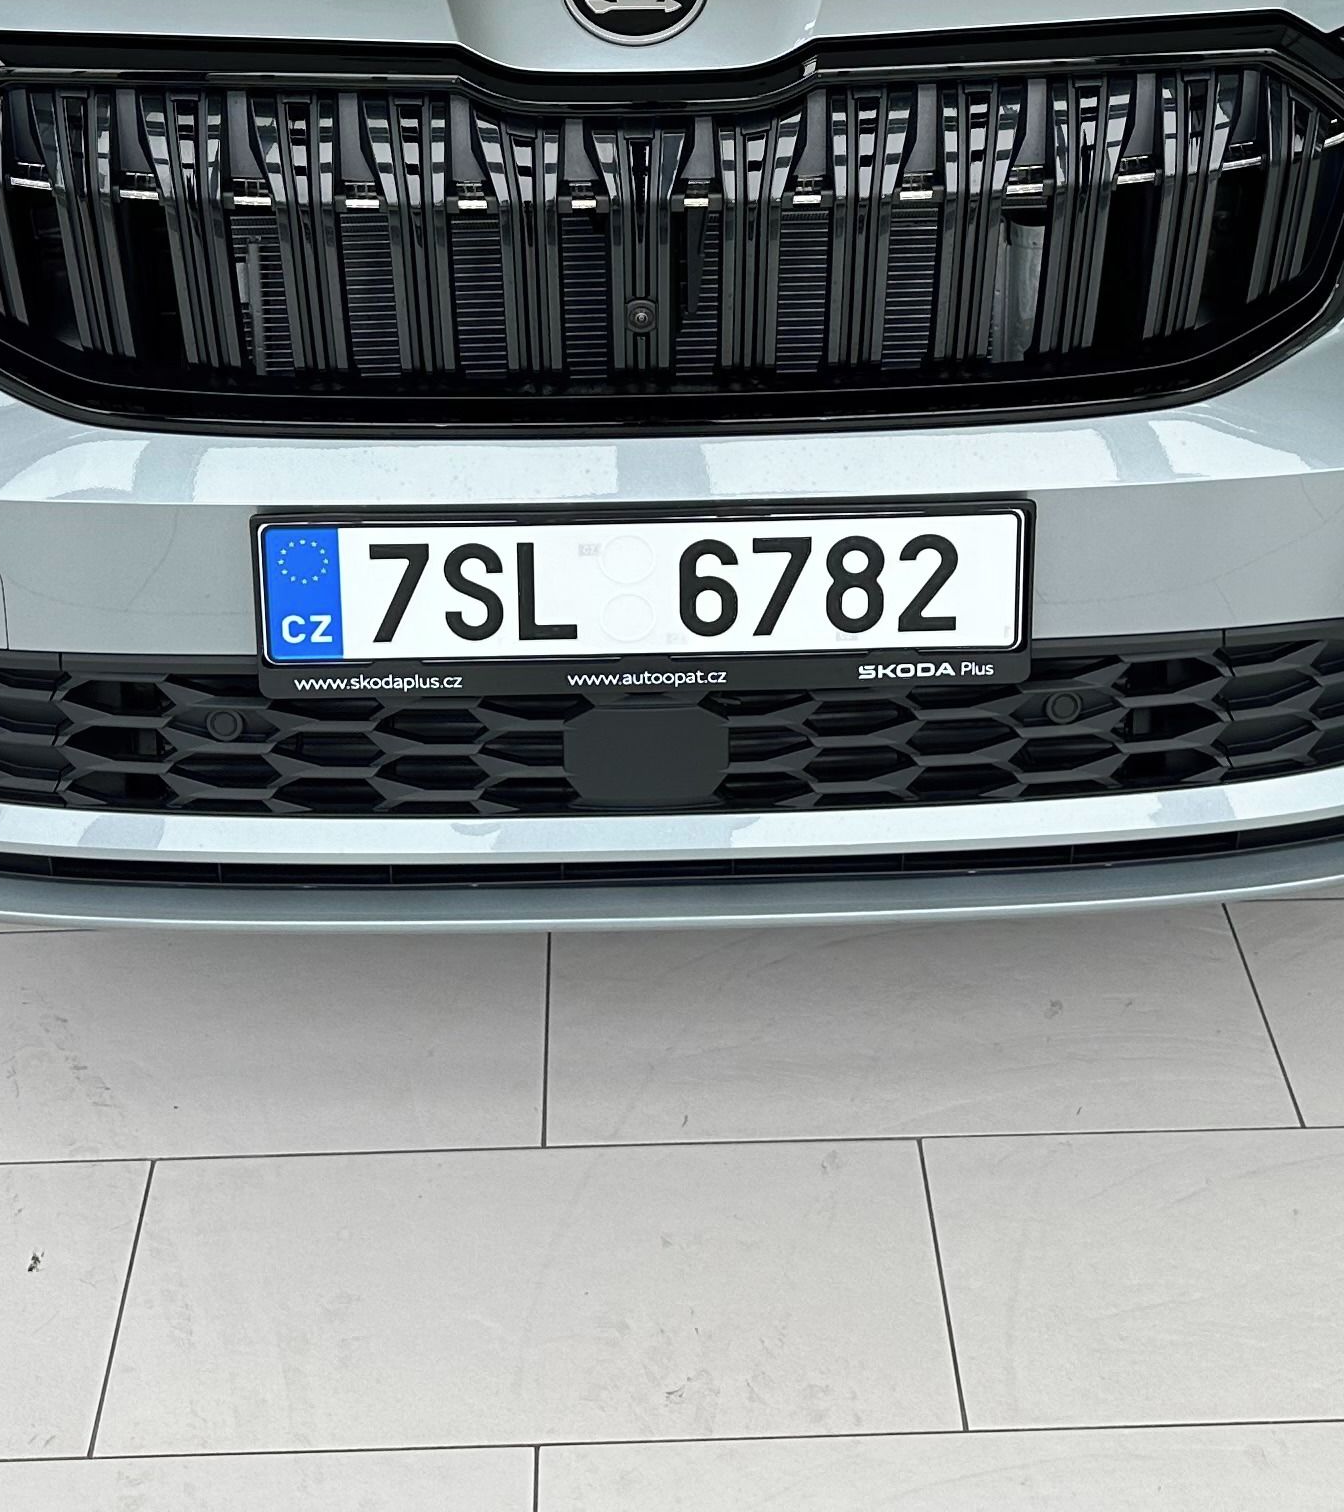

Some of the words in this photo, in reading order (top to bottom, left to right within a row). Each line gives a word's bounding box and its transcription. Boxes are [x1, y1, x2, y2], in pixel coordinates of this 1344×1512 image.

[368, 542, 578, 643] 7SL
[678, 533, 959, 637] 6782
[281, 614, 333, 644] CZ
[960, 661, 994, 676] Plus
[293, 674, 463, 692] www.skodaplus.cz
[566, 669, 727, 687] www.autoopat.cz
